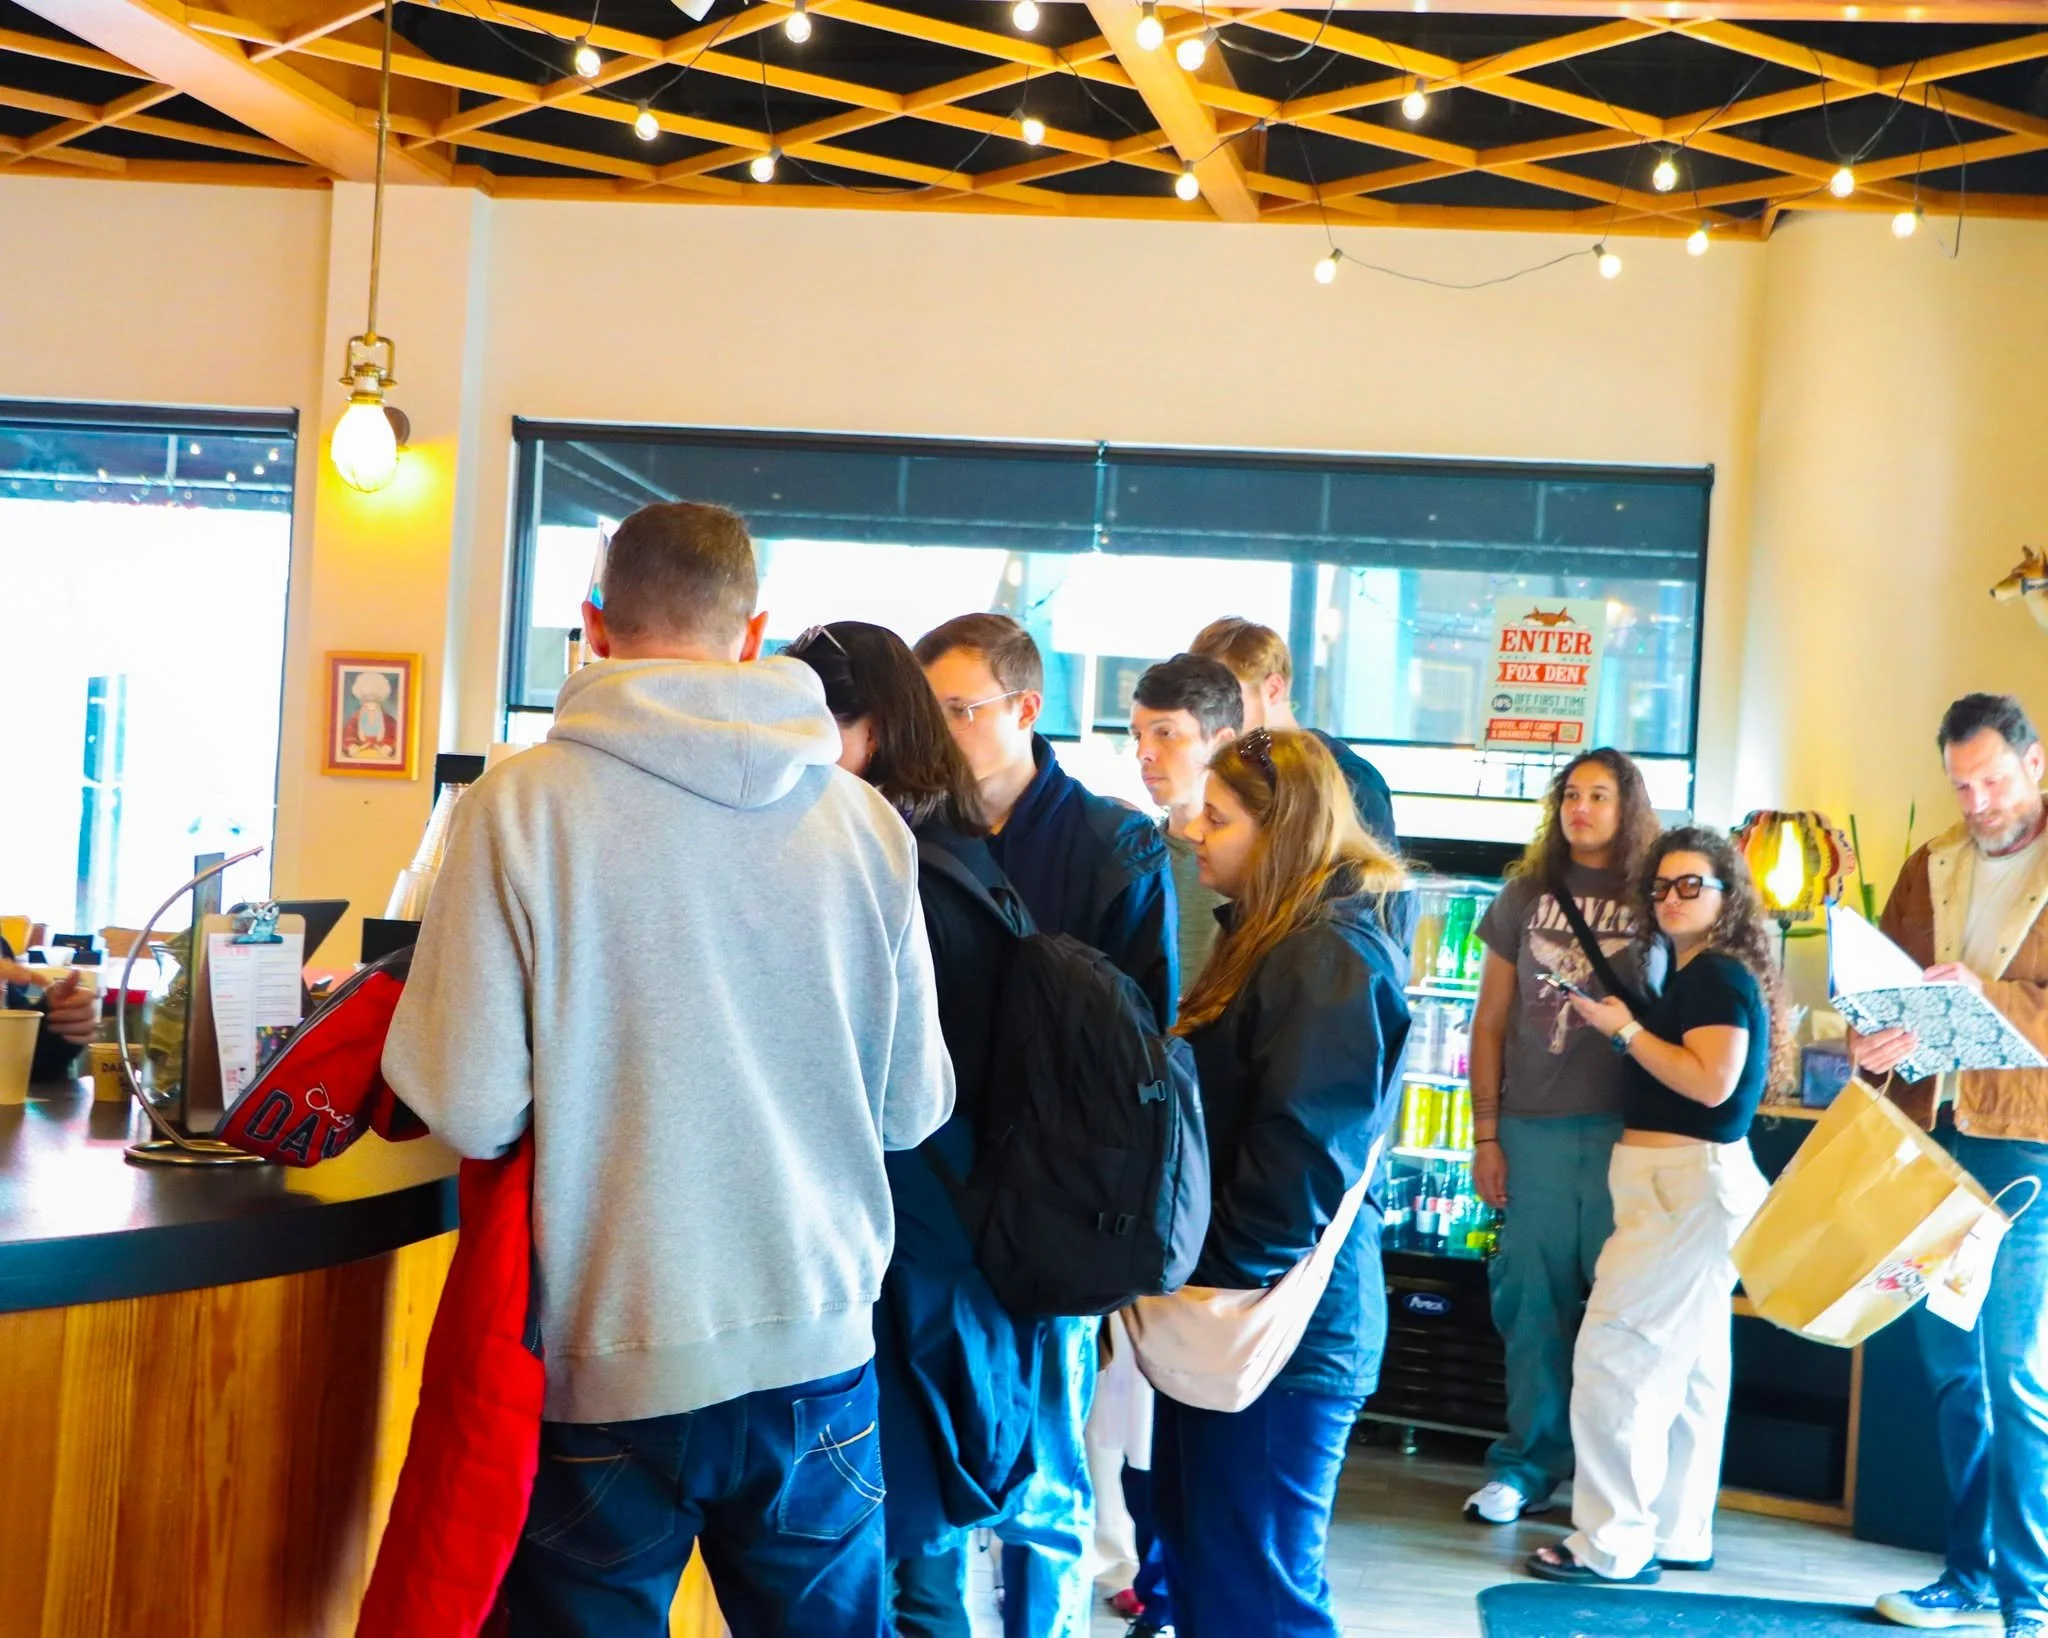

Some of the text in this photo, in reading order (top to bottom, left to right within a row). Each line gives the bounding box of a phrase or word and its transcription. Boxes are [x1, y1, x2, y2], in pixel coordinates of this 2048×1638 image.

[1499, 629, 1592, 655] ENTER
[1504, 663, 1580, 683] FOX DEN
[1515, 694, 1532, 705] OFF
[1534, 694, 1560, 706] FIRST
[1564, 696, 1586, 708] TIME
